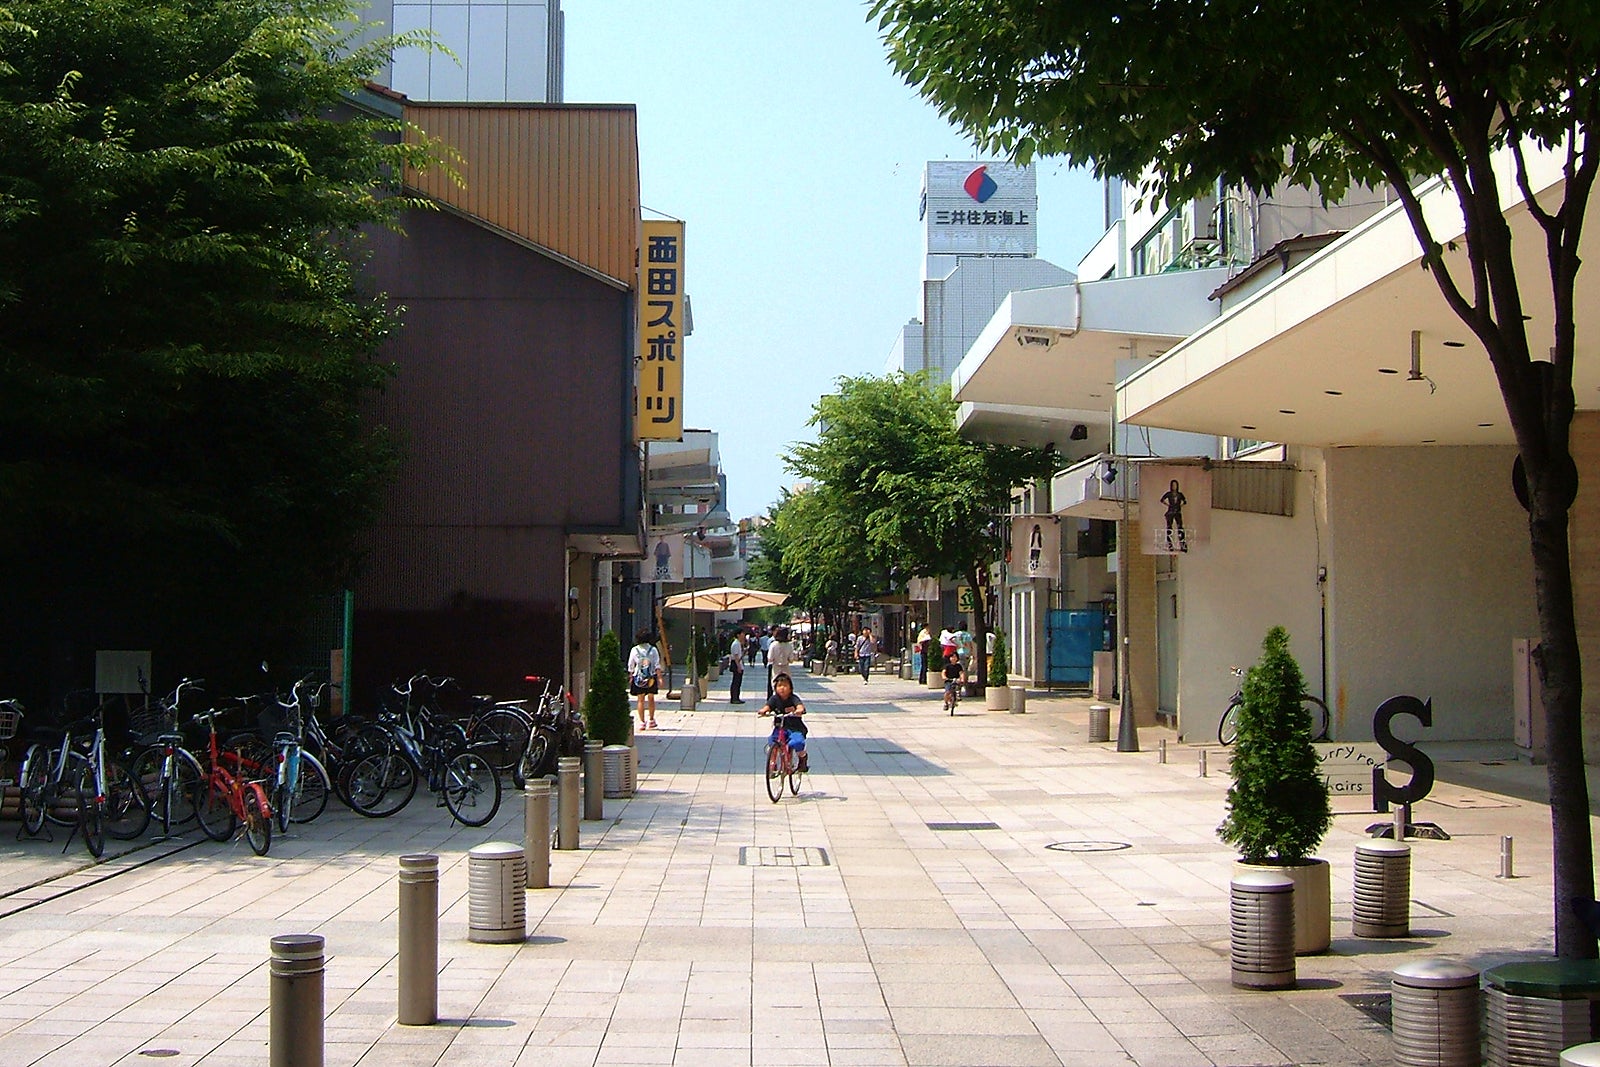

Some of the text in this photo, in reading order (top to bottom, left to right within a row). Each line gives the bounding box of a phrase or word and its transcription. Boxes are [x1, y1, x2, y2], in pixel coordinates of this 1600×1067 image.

[936, 210, 1029, 225] 三井住友海上
[646, 236, 677, 423] 西田スポーツ
[1325, 776, 1363, 792] hairs
